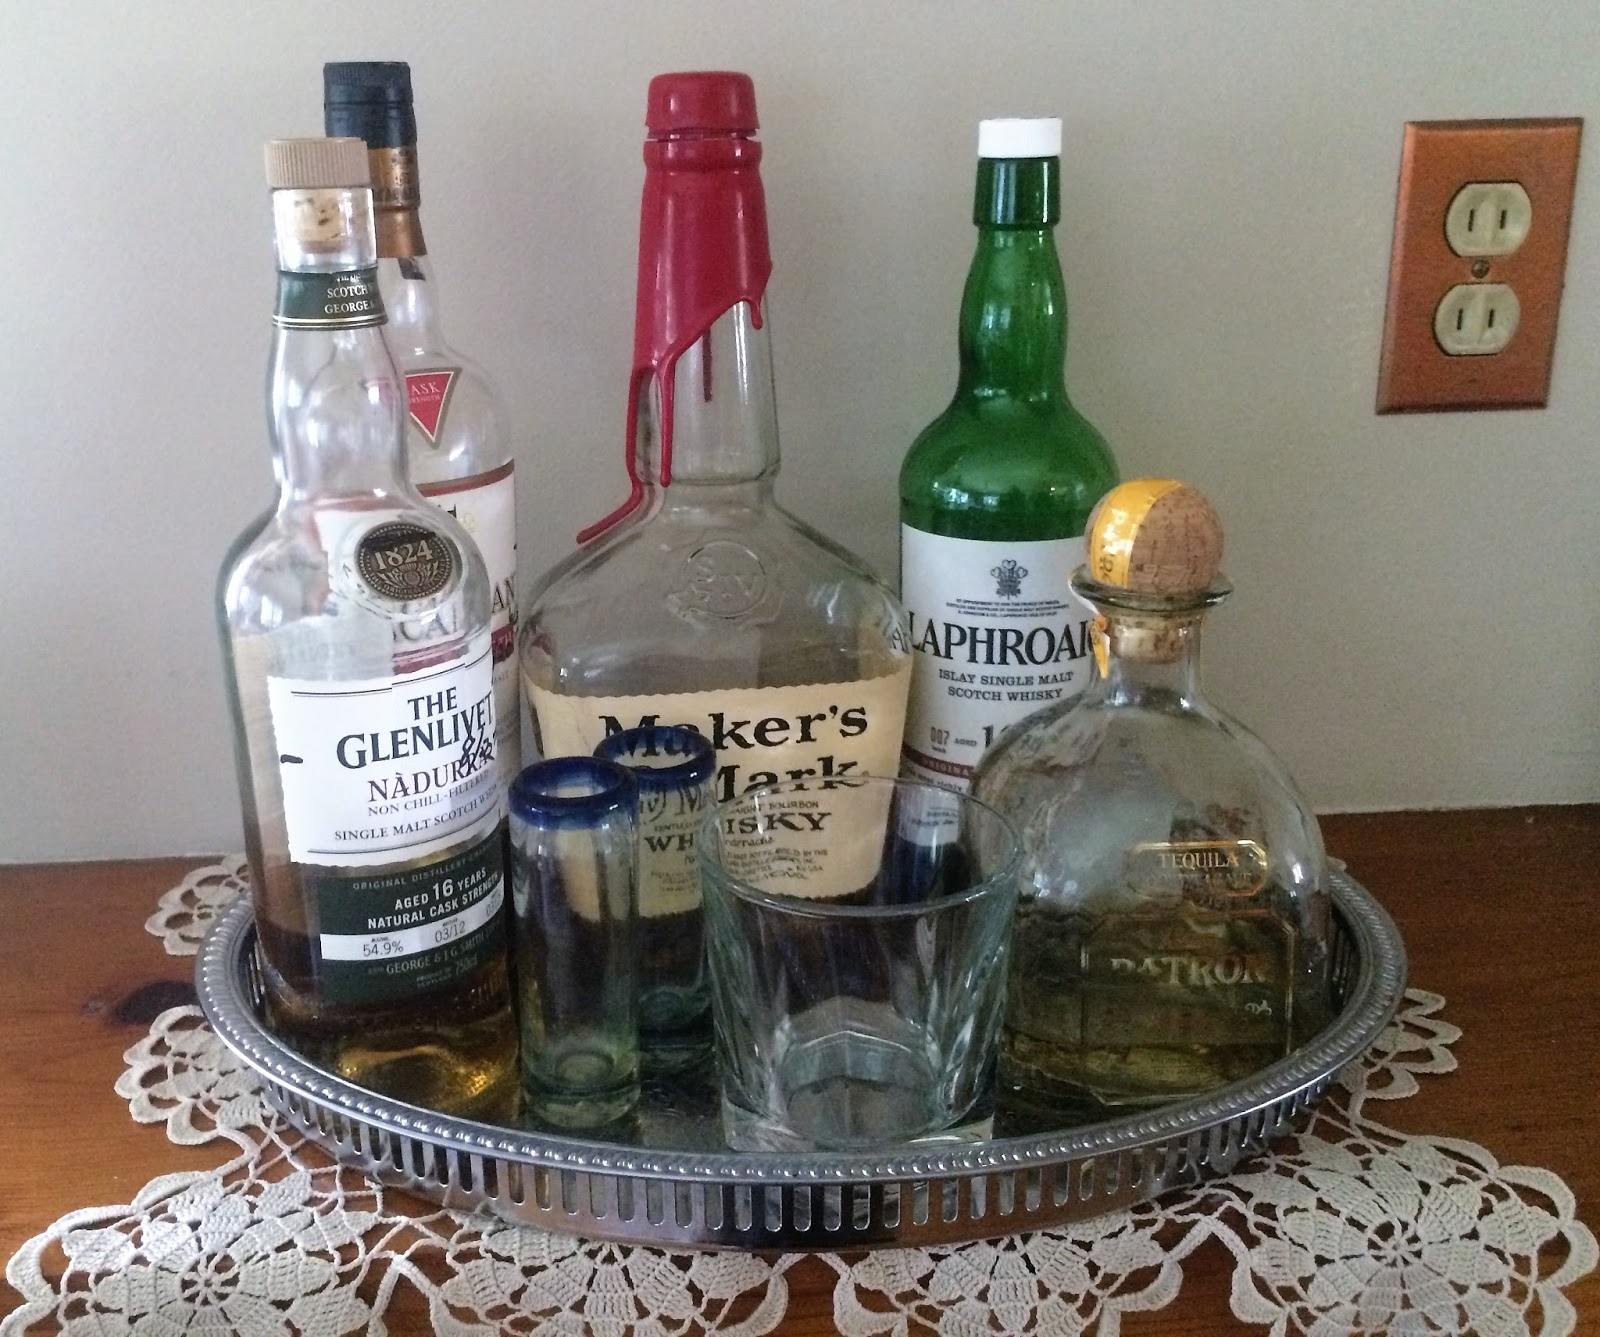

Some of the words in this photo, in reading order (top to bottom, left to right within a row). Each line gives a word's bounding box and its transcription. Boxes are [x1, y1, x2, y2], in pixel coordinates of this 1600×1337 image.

[327, 284, 369, 299] SCOTCH
[324, 300, 370, 314] GEORGE
[374, 539, 434, 571] 1824
[938, 669, 976, 684] ISLAY
[980, 675, 1034, 687] SINGLE
[1038, 670, 1074, 687] MALT
[407, 686, 458, 722] THE
[948, 686, 1002, 701] SCOTCH
[1007, 687, 1063, 702] WHISKY
[336, 690, 493, 770] GLENLIVET
[922, 757, 970, 777] ORIGINA
[334, 828, 389, 842] SINGLE
[393, 817, 431, 836] MALT
[434, 798, 478, 824] SCOTCH
[367, 804, 400, 817] NON
[1159, 852, 1240, 870] TEQUILA
[352, 877, 406, 891] ORIGINAL
[412, 857, 468, 883] DISTILLERY
[395, 892, 430, 912] AGED
[433, 878, 454, 901] 16
[457, 866, 487, 891] YEARS
[367, 912, 426, 930] NATURAL
[429, 898, 459, 918] CASK
[462, 872, 499, 905] STRENGTH
[434, 920, 466, 943] 03/12
[362, 940, 404, 957] 54.9%
[386, 955, 432, 976] GEORGE
